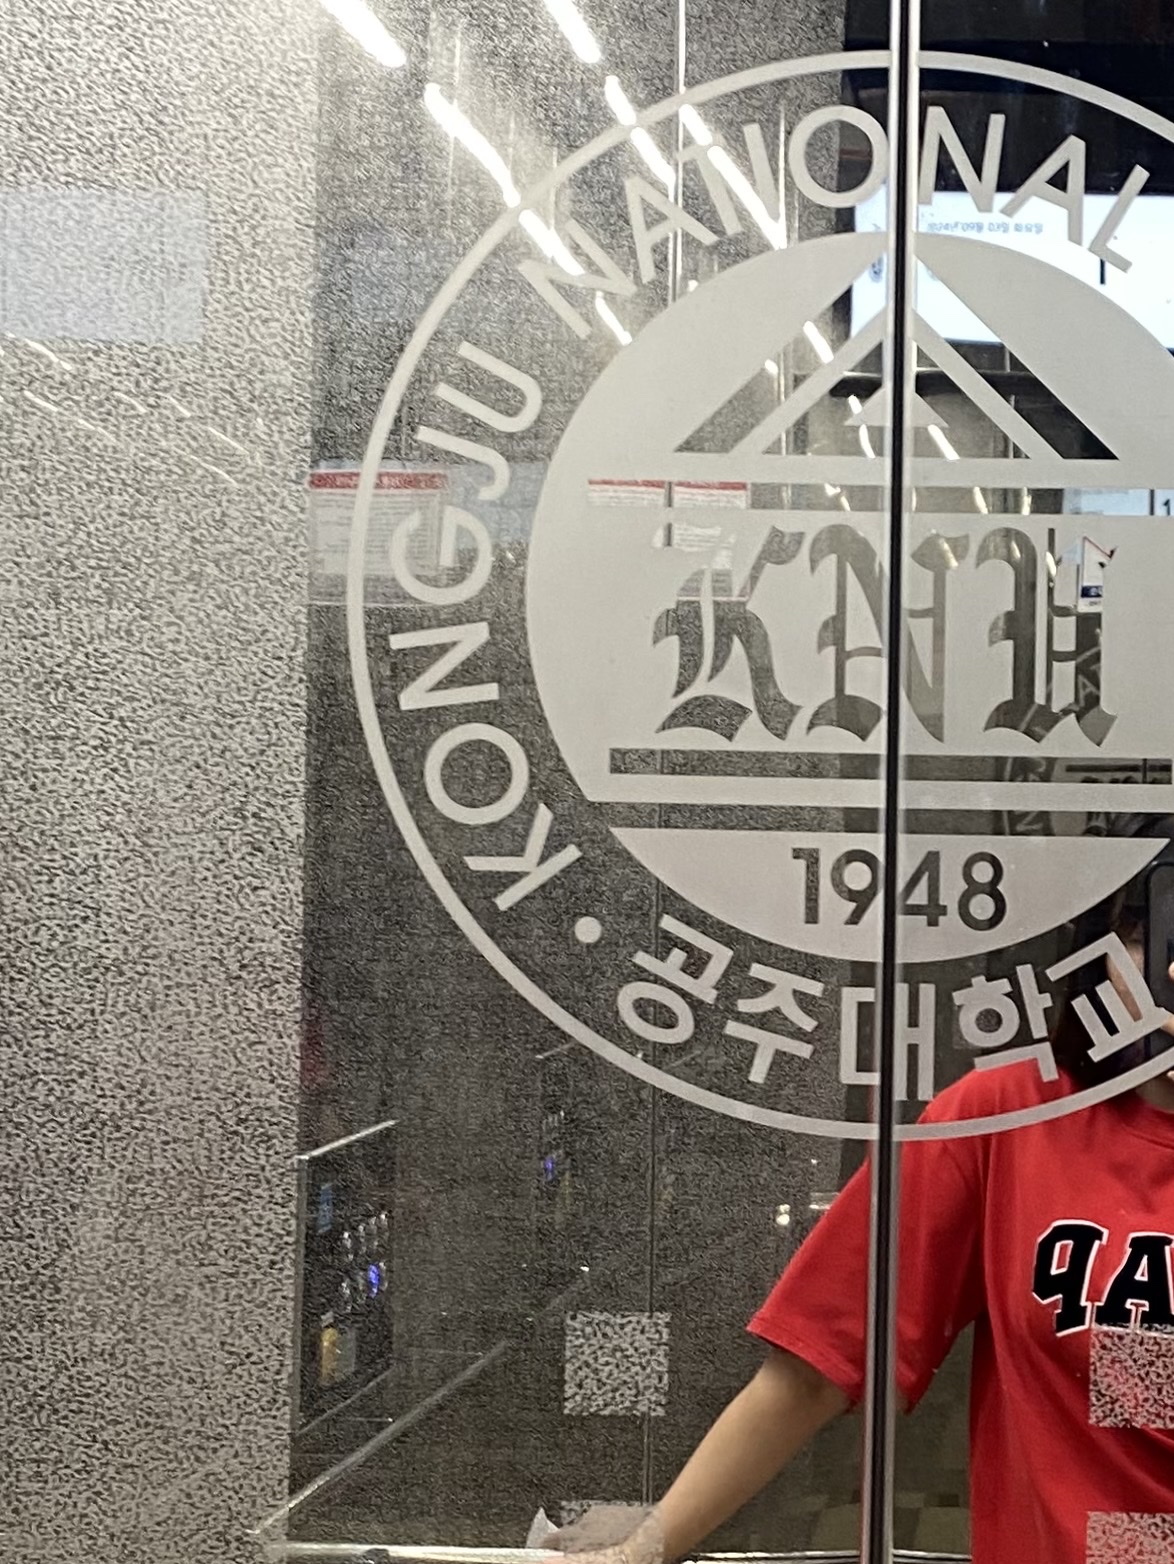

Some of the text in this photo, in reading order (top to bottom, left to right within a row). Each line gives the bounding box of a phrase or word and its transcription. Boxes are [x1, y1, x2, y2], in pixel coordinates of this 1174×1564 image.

[389, 340, 580, 911] KONGJU
[517, 105, 1150, 337] NATIONAL
[792, 849, 1007, 931] 1948
[619, 914, 1164, 1101] 공주대학교
